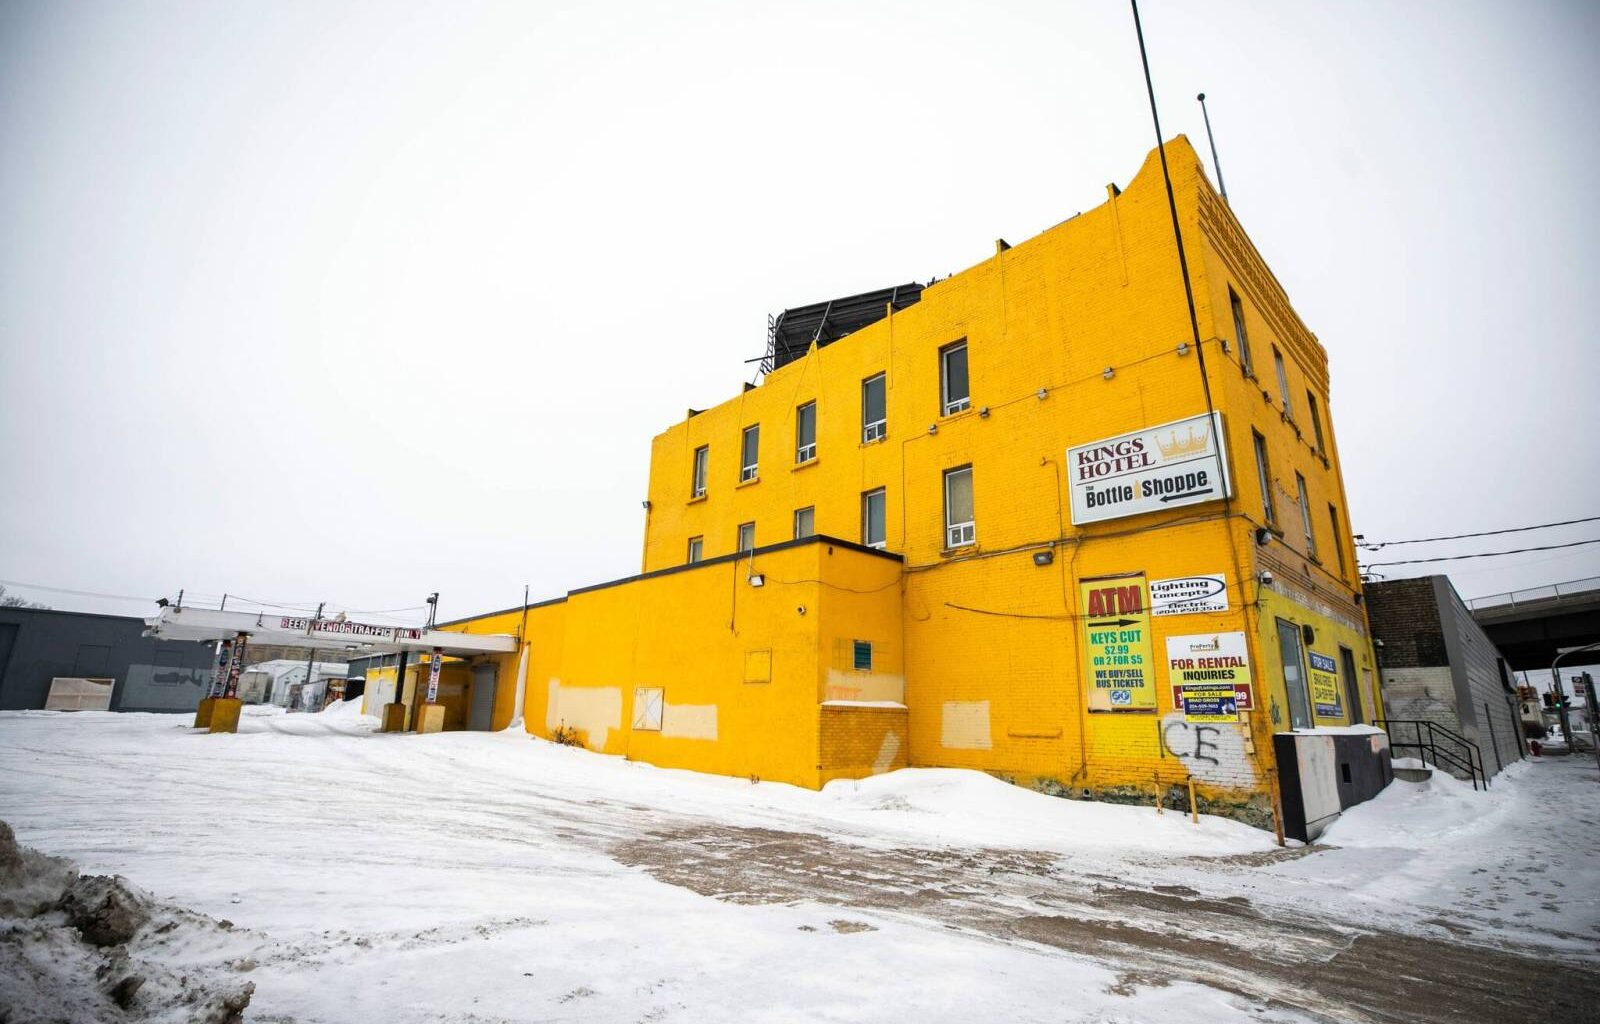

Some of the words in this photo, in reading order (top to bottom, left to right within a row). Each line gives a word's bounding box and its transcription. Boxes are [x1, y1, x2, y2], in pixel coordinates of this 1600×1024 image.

[1077, 437, 1144, 466] KINGS
[1079, 452, 1156, 480] HOTEL
[1142, 470, 1208, 497] Shoppe
[1086, 484, 1133, 508] Bottle
[1150, 581, 1209, 591] Lighting
[1152, 590, 1209, 599] Concepts
[1089, 585, 1143, 618] ATM
[1168, 601, 1209, 609] Electric
[281, 619, 306, 630] BEER
[314, 620, 353, 634] VENDOR
[353, 624, 391, 637] TRAFFIC
[398, 627, 420, 639] ONLY
[1091, 631, 1118, 644] KEYS
[1120, 630, 1141, 643] CUT
[1104, 645, 1129, 655] $2.99
[1094, 656, 1104, 666] OR
[1106, 656, 1112, 665] 2
[1114, 655, 1129, 665] FOR
[1131, 654, 1142, 664] $5
[1171, 658, 1194, 670] FOR
[1197, 656, 1247, 669] RENTAL
[1096, 670, 1107, 678] WE
[1108, 669, 1143, 678] BUY/SELL
[1183, 670, 1235, 681] INQUIRIES
[1096, 679, 1111, 688] BUS
[1112, 678, 1144, 688] TICKETS
